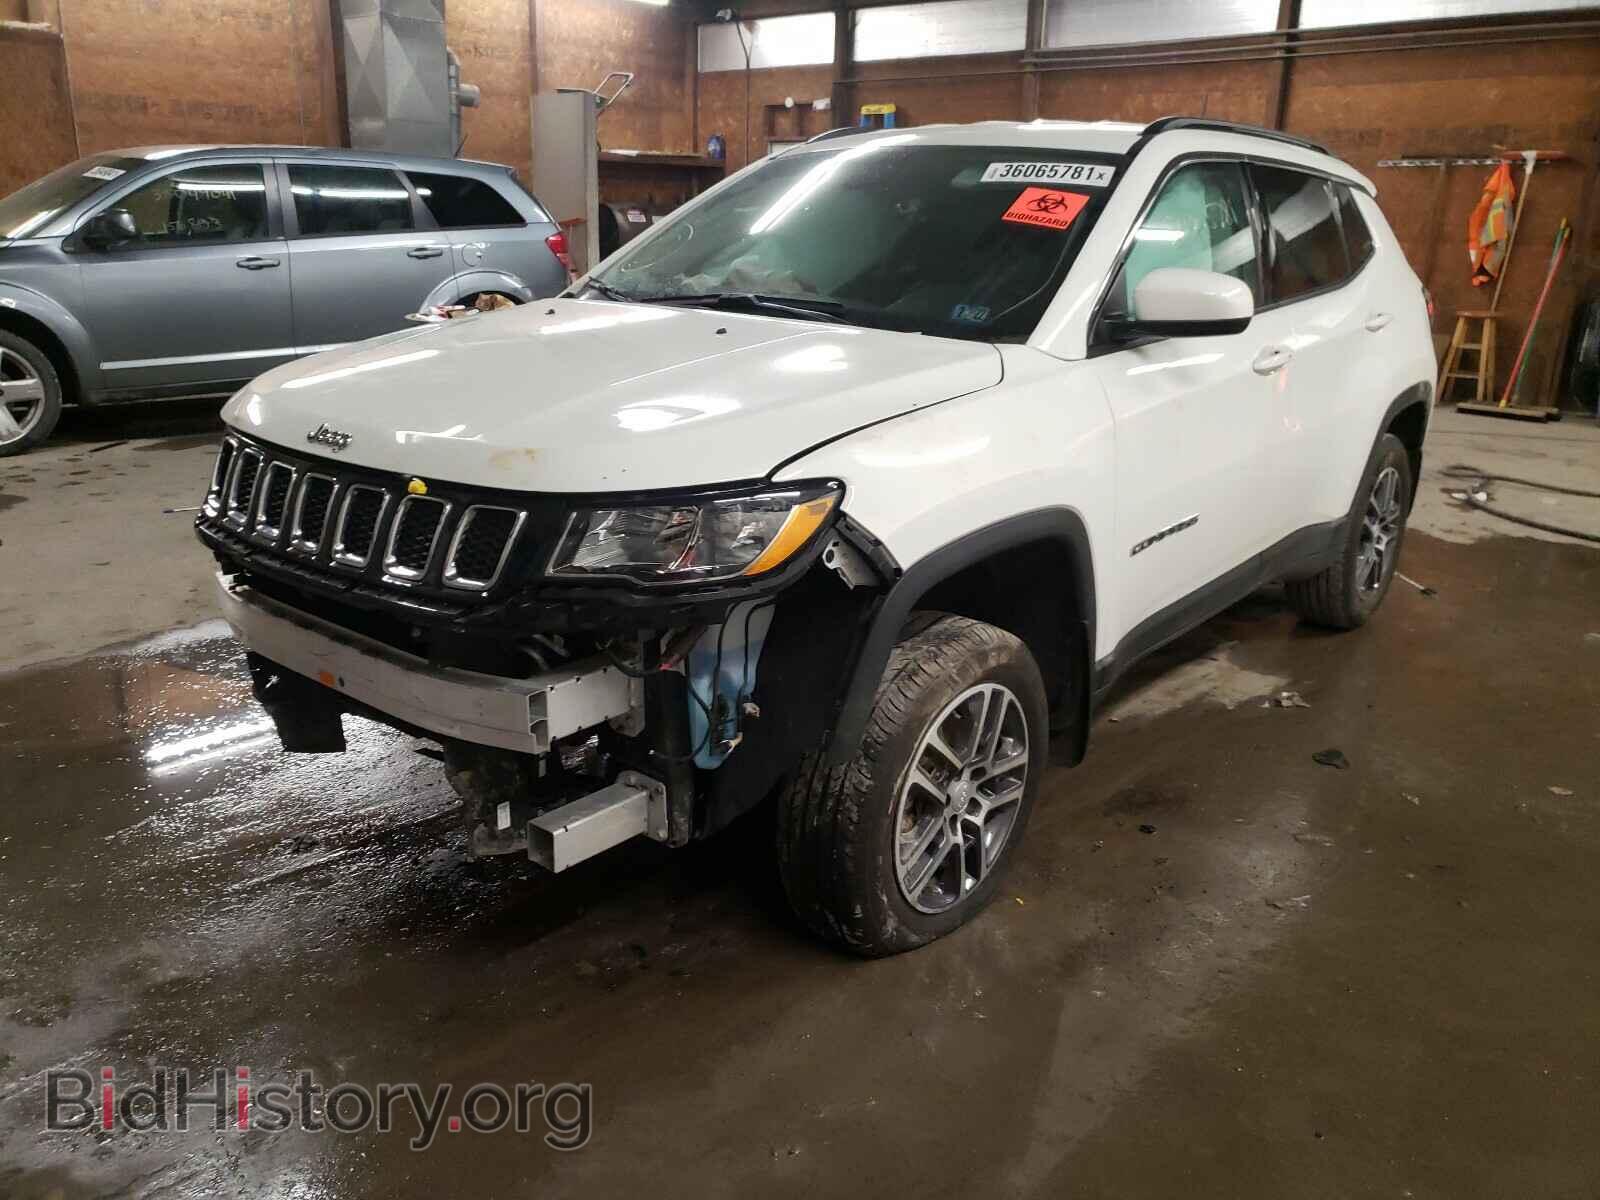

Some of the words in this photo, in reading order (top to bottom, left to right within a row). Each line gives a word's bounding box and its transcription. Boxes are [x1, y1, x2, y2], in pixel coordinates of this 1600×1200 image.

[1000, 164, 1095, 181] 36065781
[1006, 211, 1069, 228] BIOHAZARD
[307, 423, 352, 453] Jeep
